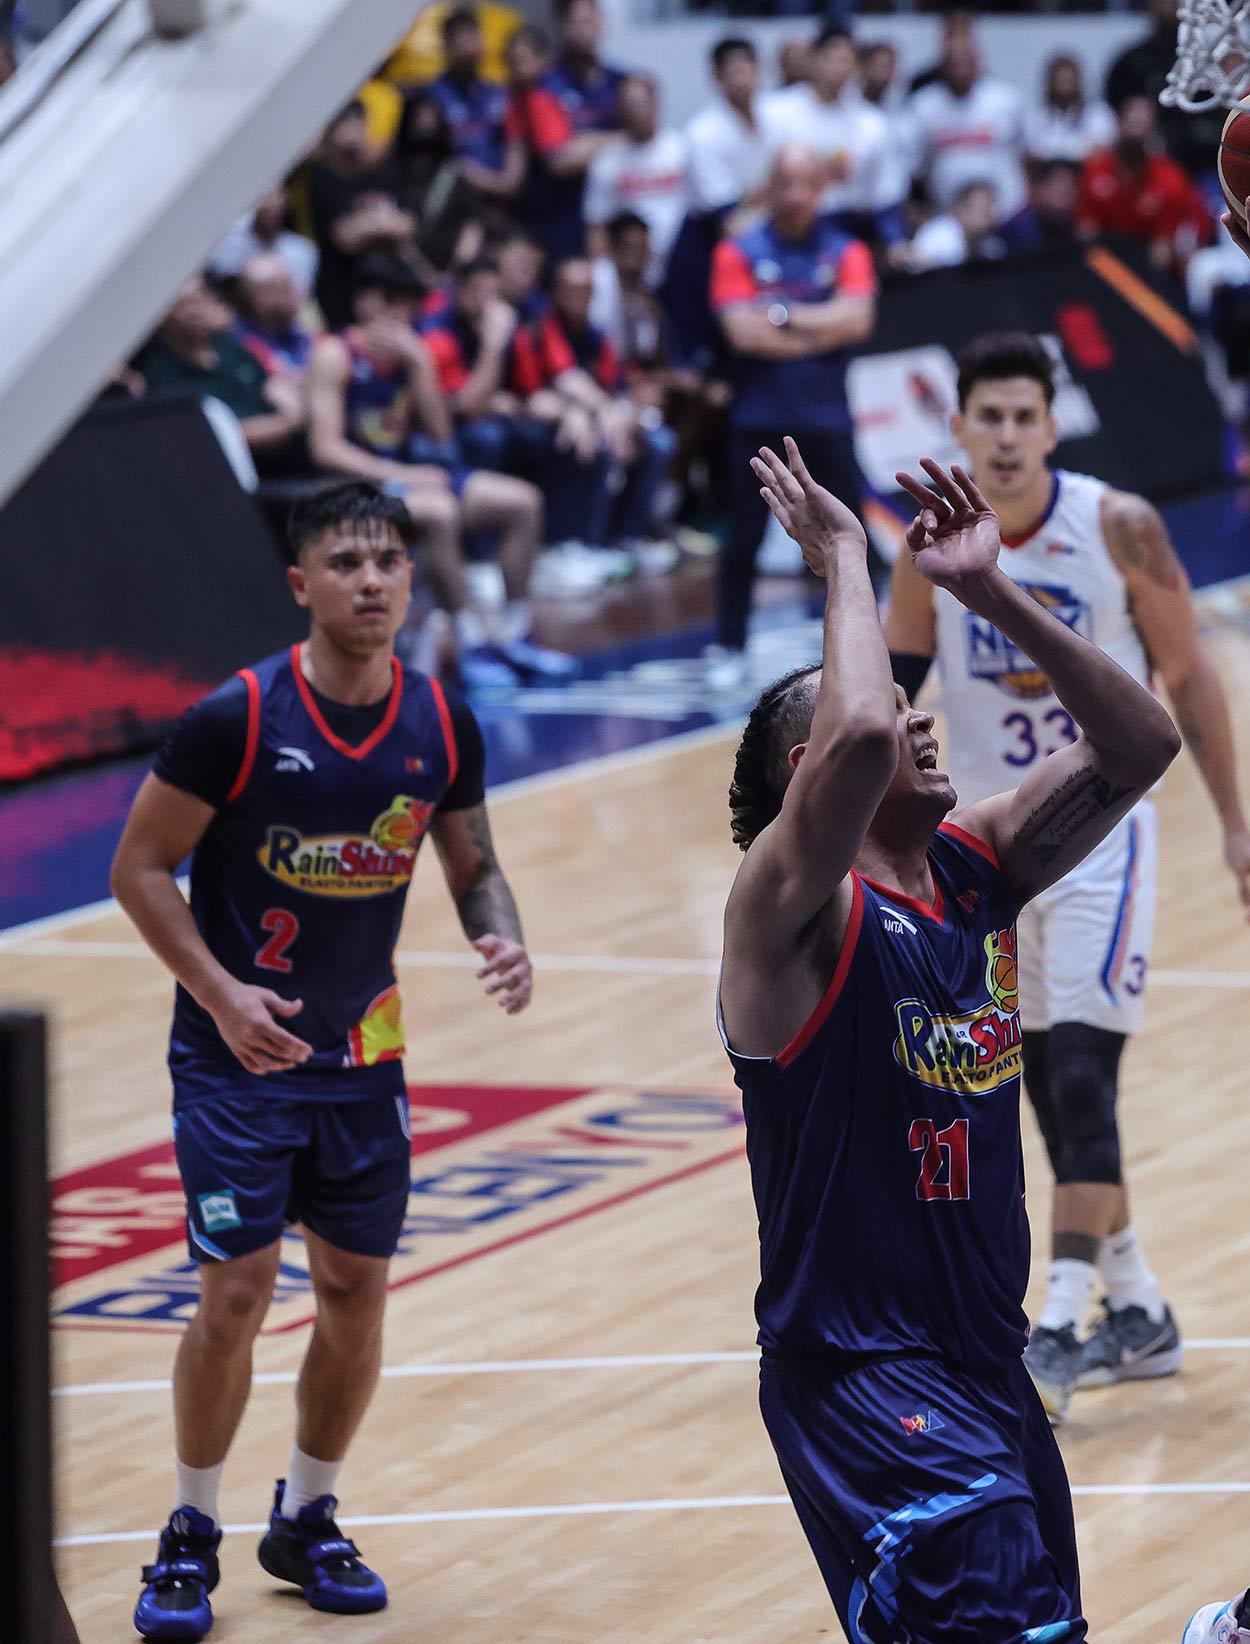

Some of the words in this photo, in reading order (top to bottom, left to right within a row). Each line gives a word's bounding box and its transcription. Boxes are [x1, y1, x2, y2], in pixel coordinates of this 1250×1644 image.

[268, 829, 338, 875] Rain
[255, 908, 299, 973] 2
[908, 1118, 971, 1202] 21
